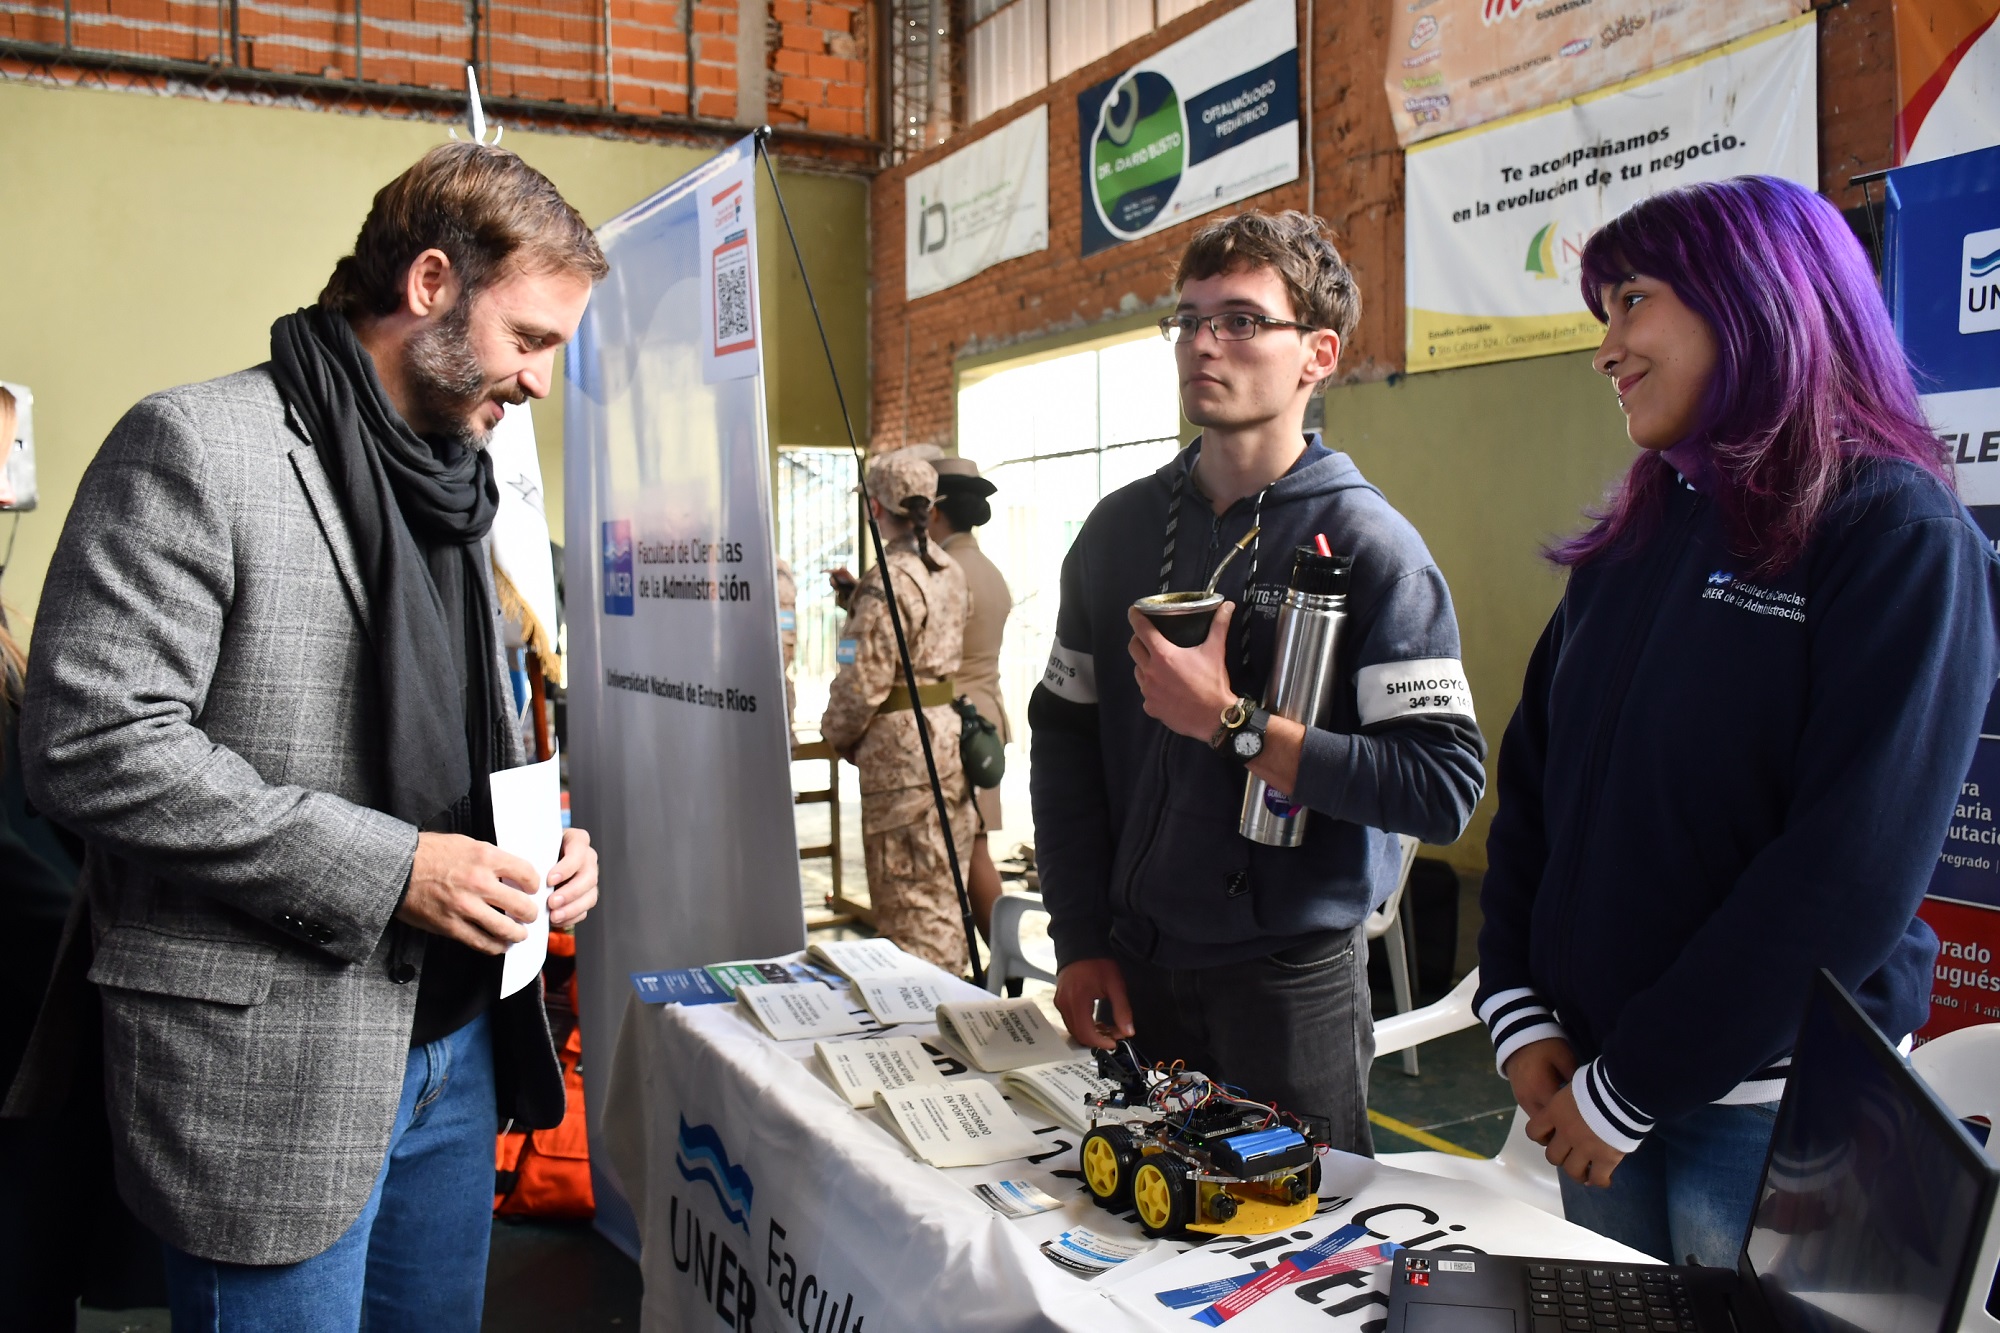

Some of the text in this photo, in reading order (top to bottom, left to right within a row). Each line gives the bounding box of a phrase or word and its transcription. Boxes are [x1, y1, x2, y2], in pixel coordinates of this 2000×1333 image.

[1202, 79, 1276, 124] OFTALMÓLOGO
[1216, 101, 1269, 138] PEDIÁTRICO
[1097, 162, 1113, 181] DR.
[1148, 132, 1181, 160] BUSTO
[1453, 132, 1747, 223] en la evolución de tu negocio.
[1501, 166, 1523, 184] Te
[637, 537, 743, 564] Facultad de Ciencias
[639, 575, 750, 601] de la Administración
[1723, 593, 1735, 603] de
[1735, 595, 1744, 606] la
[606, 668, 757, 713] Universidad Nacional de Entre Ríos
[1973, 1002, 1980, 1014] 4
[869, 1061, 895, 1090] COMPUTACIÓ
[877, 1051, 905, 1086] UNIVERSITARIA
[889, 1050, 915, 1082] TECNICATURA
[949, 1102, 980, 1139] PORTUGUÉS
[956, 1093, 992, 1136] PROFESORADO
[670, 1195, 757, 1333] UNER
